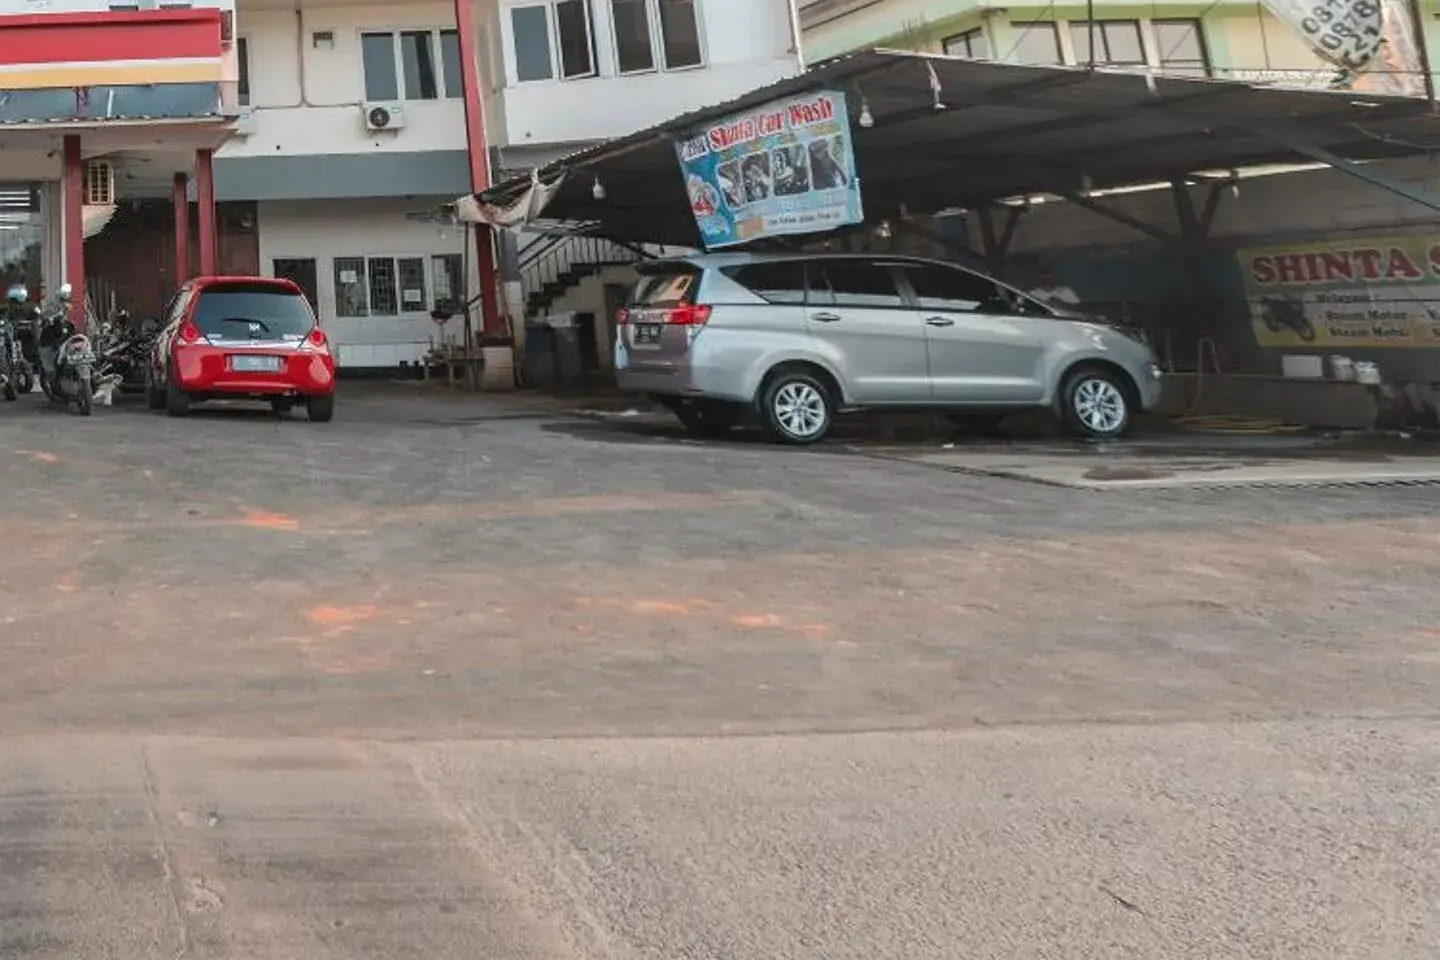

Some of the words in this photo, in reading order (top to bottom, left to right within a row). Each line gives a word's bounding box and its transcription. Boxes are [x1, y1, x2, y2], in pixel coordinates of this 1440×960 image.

[710, 119, 755, 149] Shinta
[760, 110, 785, 134] Car
[789, 96, 833, 127] Wash
[1252, 247, 1422, 283] SHINTA
